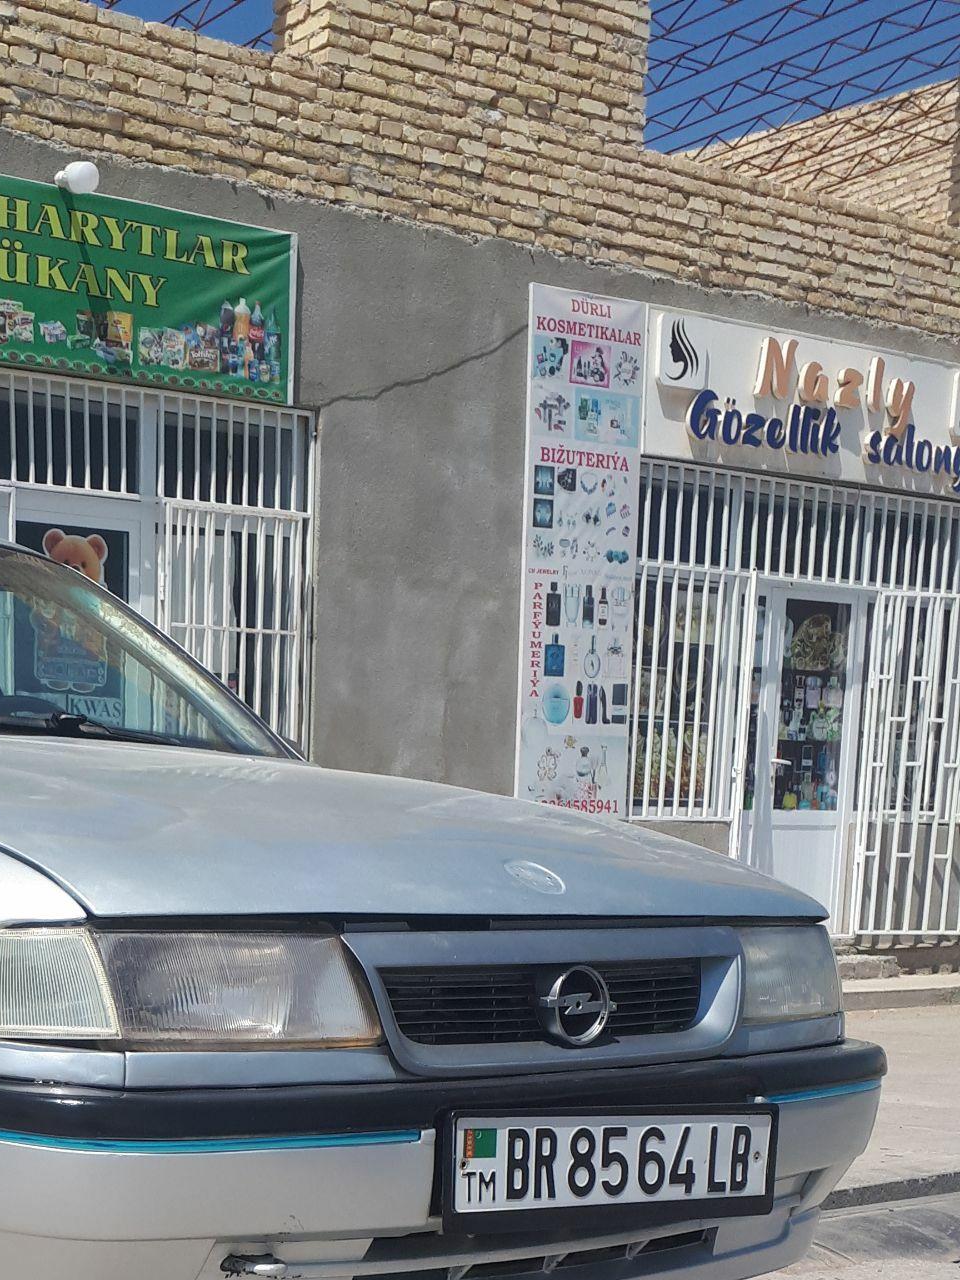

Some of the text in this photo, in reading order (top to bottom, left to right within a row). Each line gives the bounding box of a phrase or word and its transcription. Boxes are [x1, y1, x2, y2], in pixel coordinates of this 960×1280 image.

[571, 298, 612, 319] DÜRLI
[536, 315, 642, 346] KOSMETIKALAR
[753, 336, 916, 437] Nazly
[687, 388, 841, 456] Gözellik
[540, 443, 630, 472] BIŽUTERIÝA
[461, 1171, 496, 1202] TM
